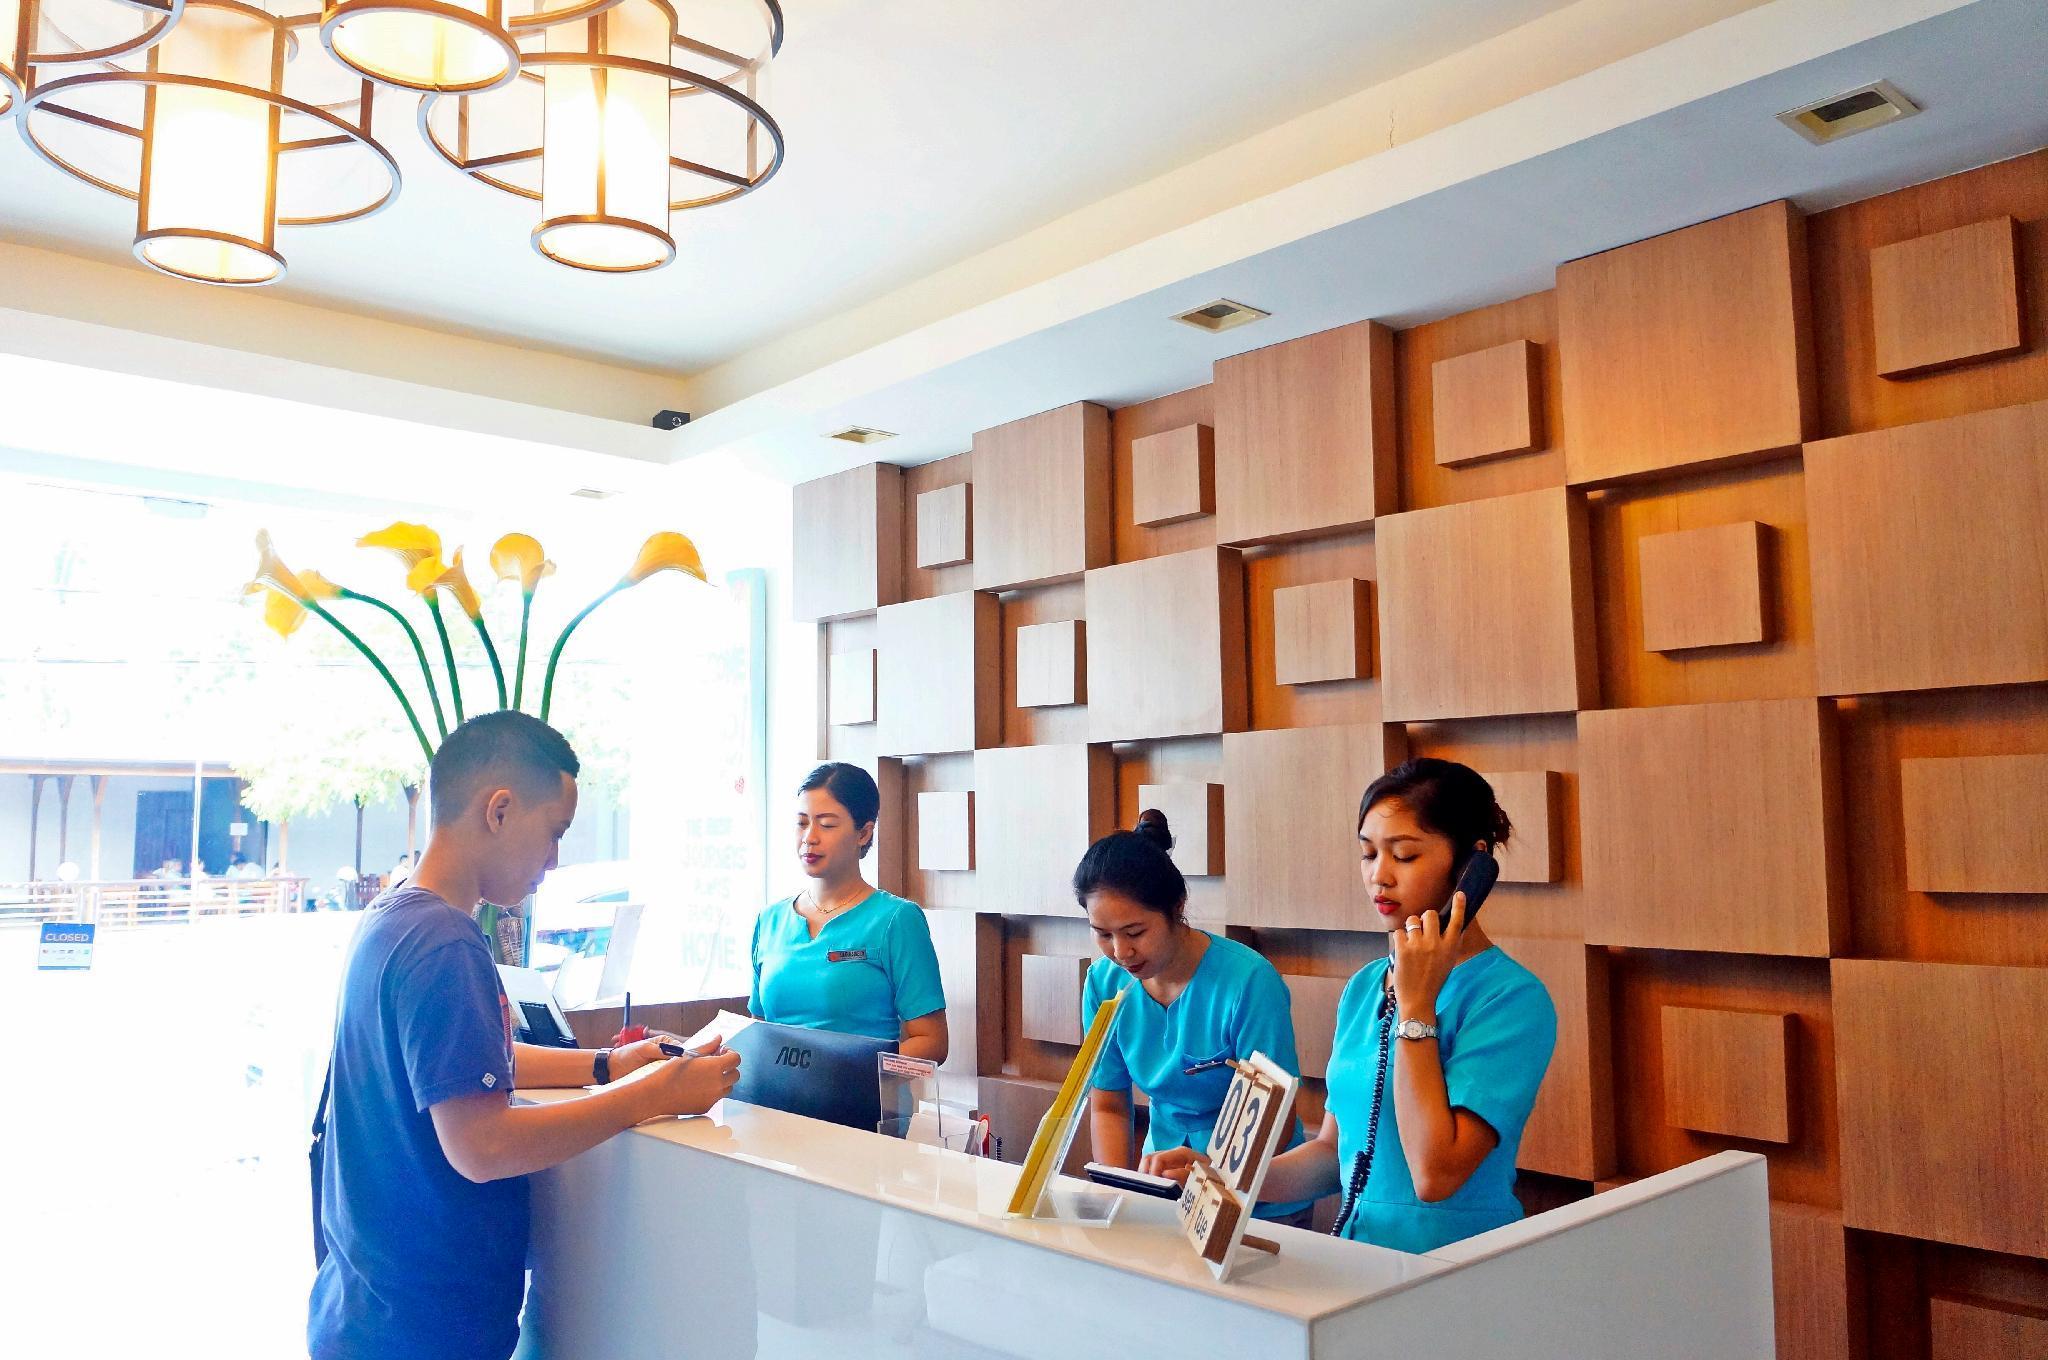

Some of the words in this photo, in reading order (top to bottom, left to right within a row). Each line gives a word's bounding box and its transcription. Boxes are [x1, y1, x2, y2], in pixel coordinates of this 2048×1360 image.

[45, 933, 89, 942] CLOSED
[774, 1046, 812, 1069] AOC
[1215, 1079, 1260, 1173] 03
[1194, 1205, 1208, 1240] tue
